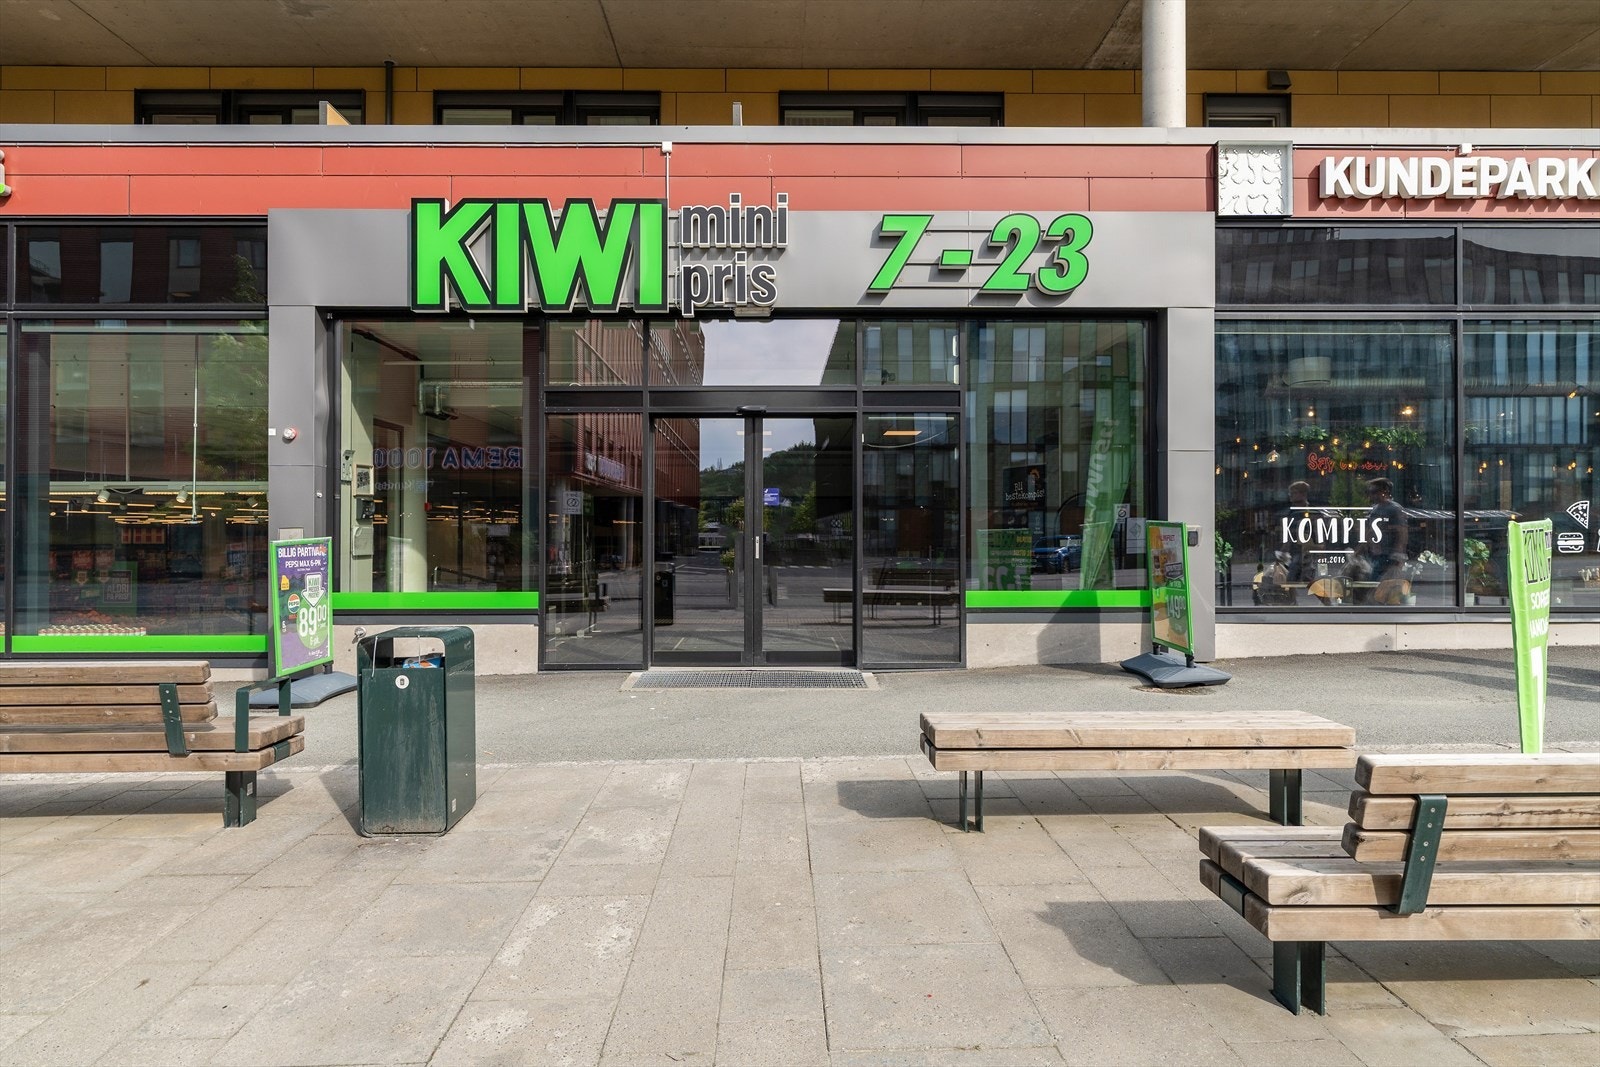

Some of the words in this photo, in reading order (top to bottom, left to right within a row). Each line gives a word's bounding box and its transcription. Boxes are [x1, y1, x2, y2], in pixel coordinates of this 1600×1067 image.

[1320, 155, 1600, 200] KUNDEPARK
[681, 192, 789, 249] mini
[411, 197, 669, 313] KIWI
[866, 213, 935, 294] 7
[980, 212, 1095, 296] 23
[681, 251, 779, 318] pris
[278, 547, 297, 558] BILLIG
[1282, 516, 1383, 544] KOMPIS
[285, 560, 299, 568] PEPSI
